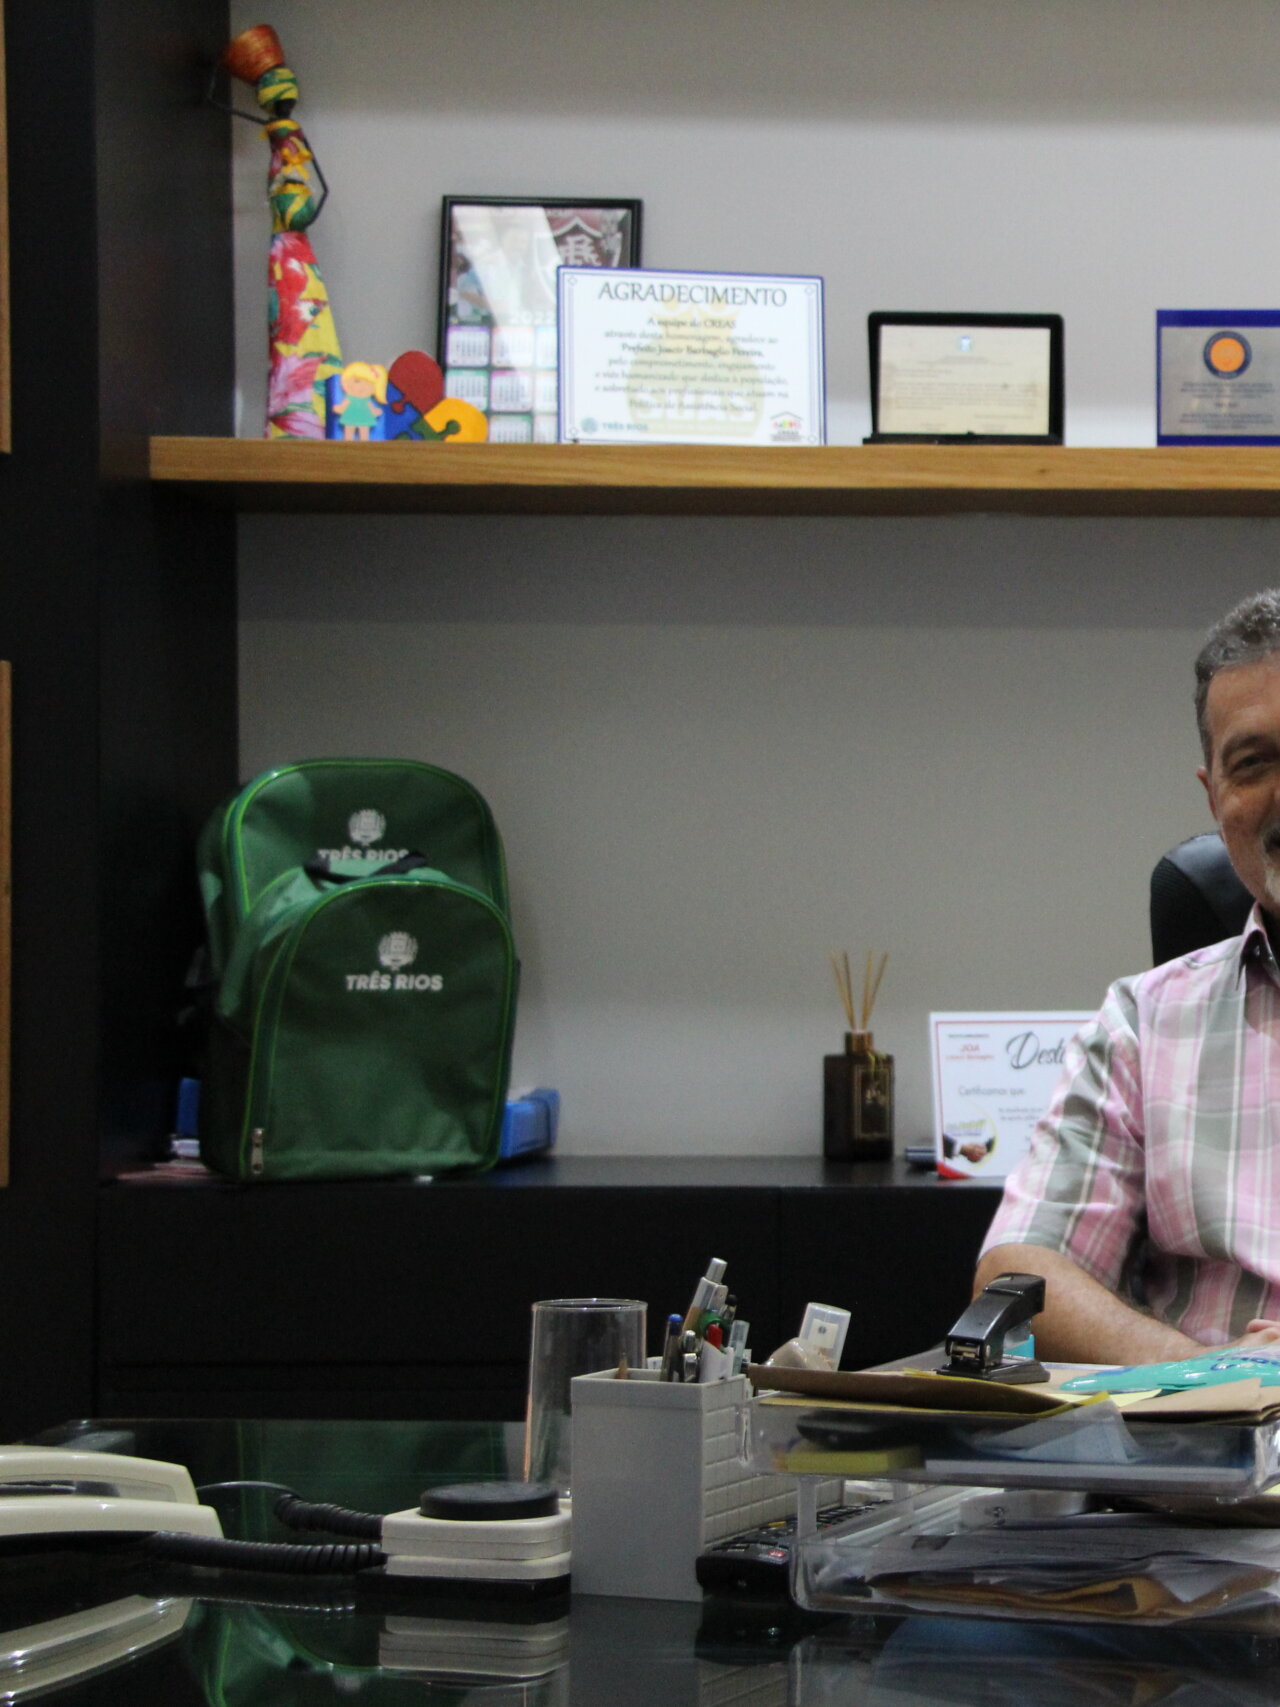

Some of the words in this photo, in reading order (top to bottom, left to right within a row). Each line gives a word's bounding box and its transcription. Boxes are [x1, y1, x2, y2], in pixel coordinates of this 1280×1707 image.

[598, 281, 787, 307] AGRADECIMENTO
[346, 970, 391, 990] TRÊS
[393, 974, 443, 991] RIOS
